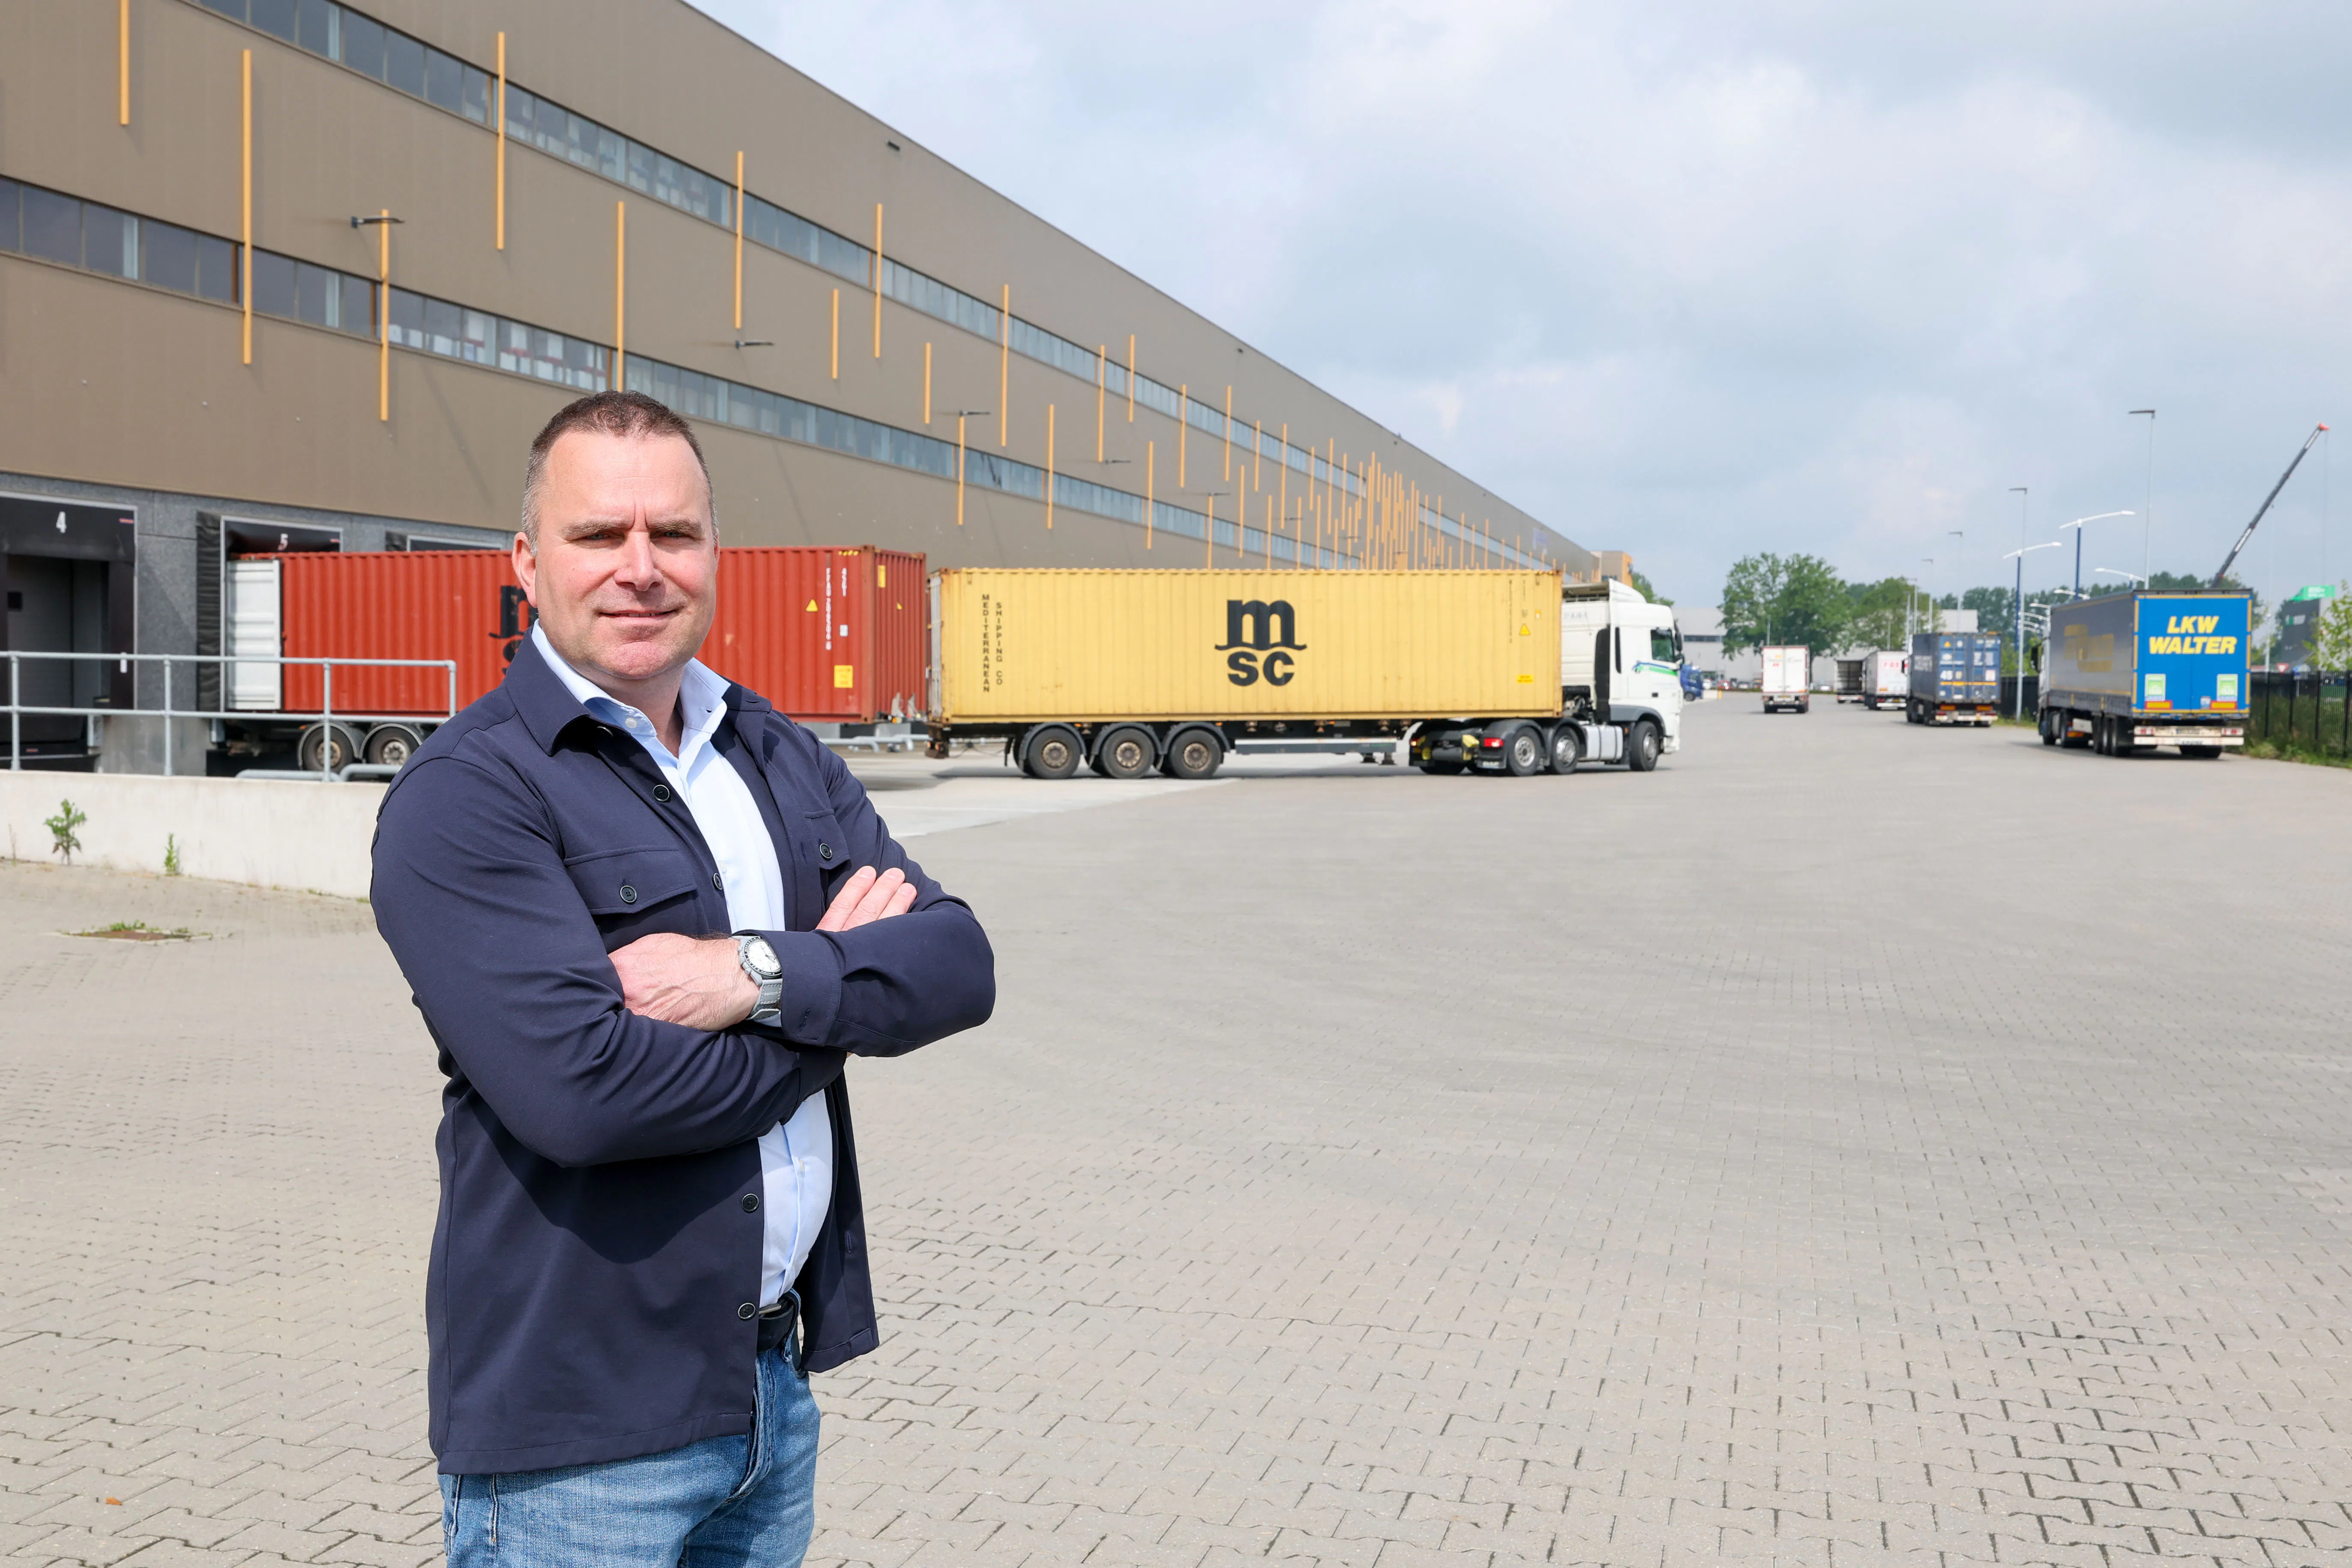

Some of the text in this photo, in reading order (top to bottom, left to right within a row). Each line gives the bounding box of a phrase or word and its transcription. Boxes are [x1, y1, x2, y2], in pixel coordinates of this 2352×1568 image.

[56, 511, 67, 533] 4
[278, 533, 289, 550] 5
[2167, 615, 2220, 634] LKW
[982, 594, 990, 693] MEDITERRANEAN
[2149, 636, 2238, 654] WALTER
[996, 670, 1003, 685] CO
